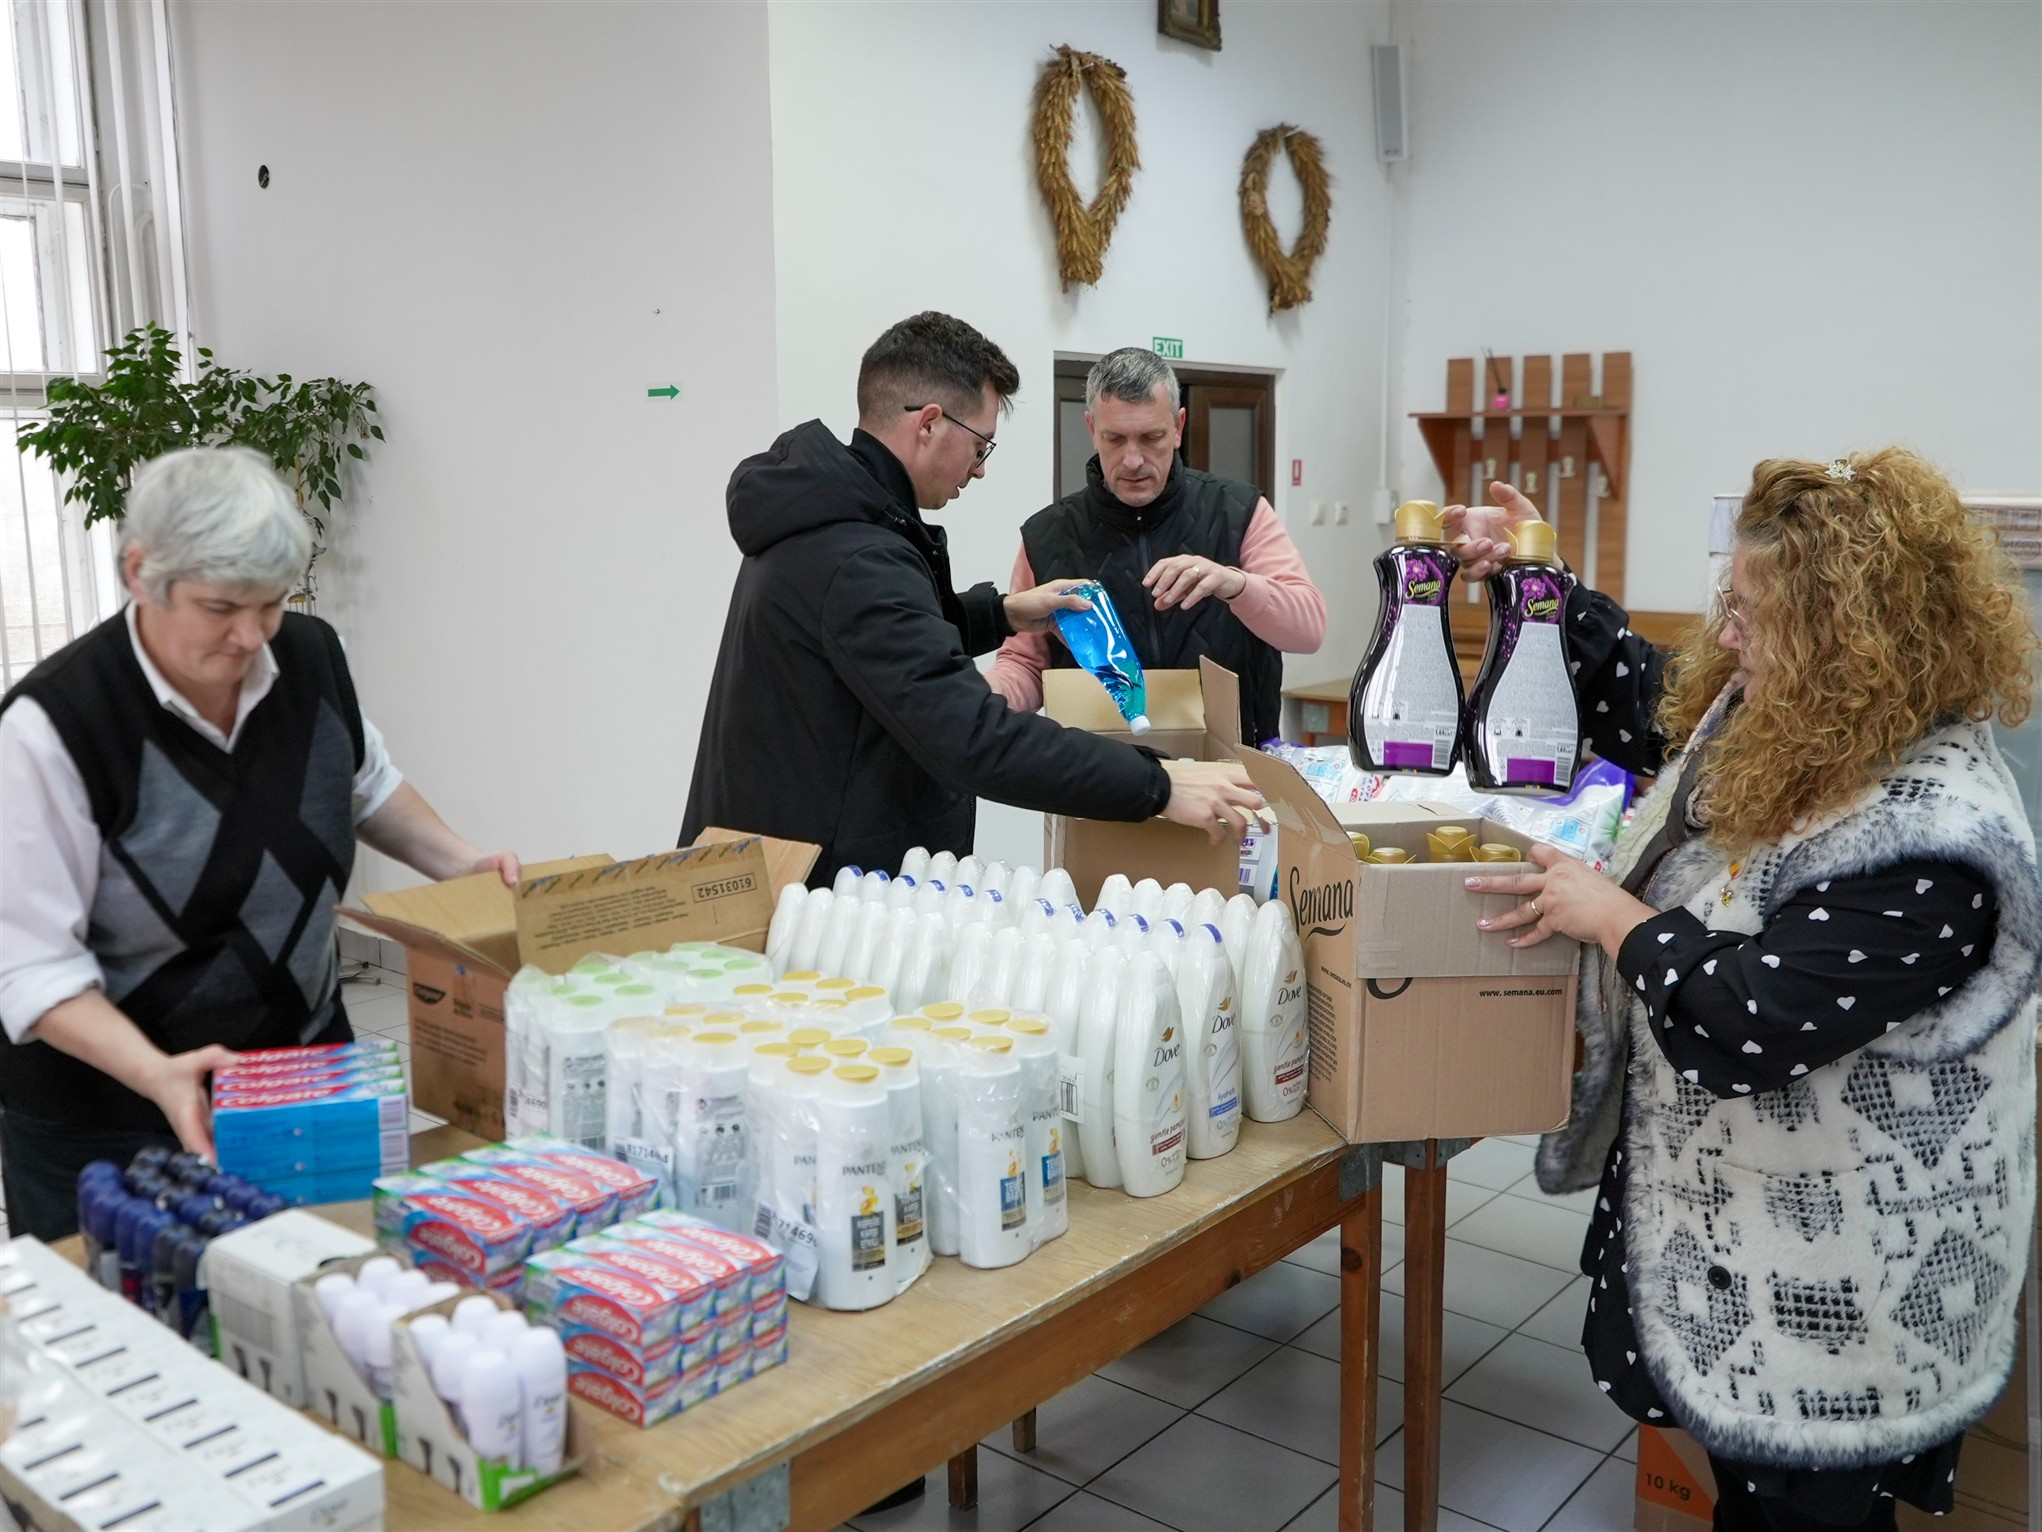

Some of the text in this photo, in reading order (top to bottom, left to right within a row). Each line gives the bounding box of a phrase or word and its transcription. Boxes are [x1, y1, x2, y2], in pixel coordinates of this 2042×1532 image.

[1154, 339, 1182, 358] EXIT
[1405, 578, 1442, 599] Semana
[1523, 597, 1560, 617] Semana
[696, 876, 752, 899] 61031542
[1289, 866, 1354, 936] Semana
[1278, 986, 1302, 1005] Dove
[1212, 1013, 1236, 1034] Dove
[239, 1048, 327, 1065] olgate
[1153, 1043, 1181, 1067] Dove
[570, 1266, 655, 1306] Colgate
[570, 1300, 639, 1343] Colgate
[572, 1340, 640, 1383] Colgate
[573, 1377, 641, 1422] Colgate
[1645, 1473, 1691, 1501] 10 kg
